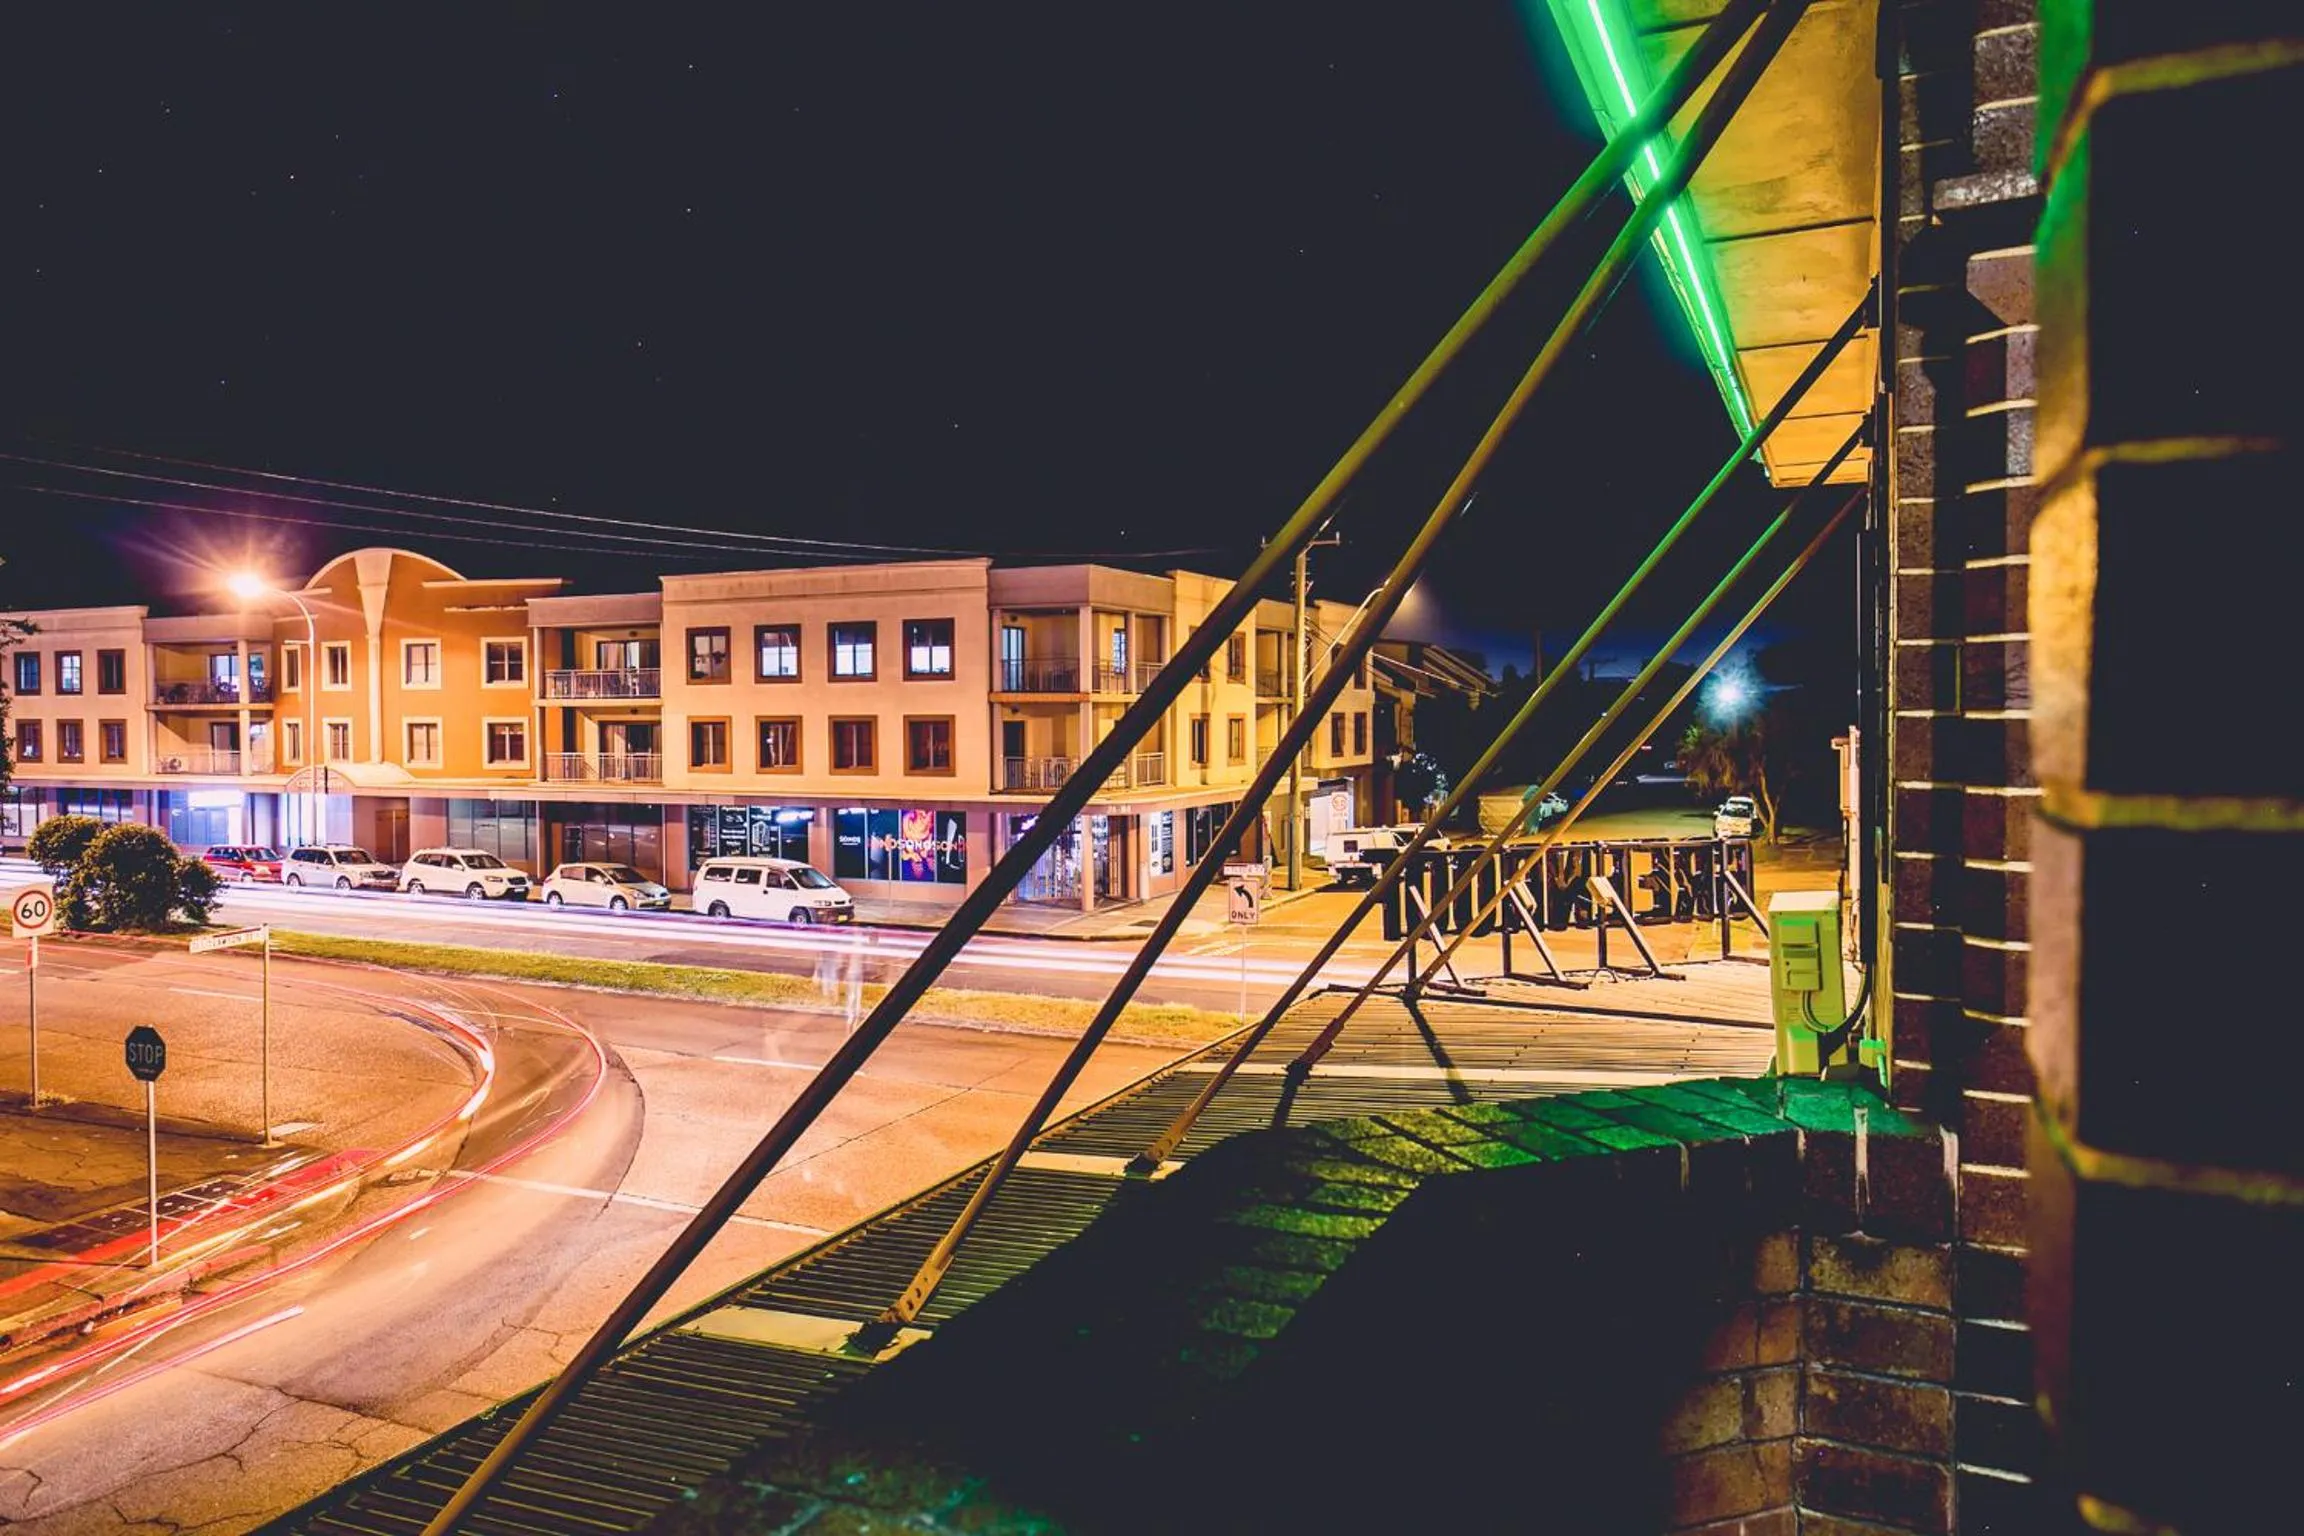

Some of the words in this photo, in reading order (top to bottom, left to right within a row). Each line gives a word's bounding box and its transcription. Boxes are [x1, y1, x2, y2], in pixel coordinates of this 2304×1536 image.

[21, 900, 46, 919] 60
[1231, 910, 1256, 920] ONLY
[128, 1042, 163, 1065] STOP
